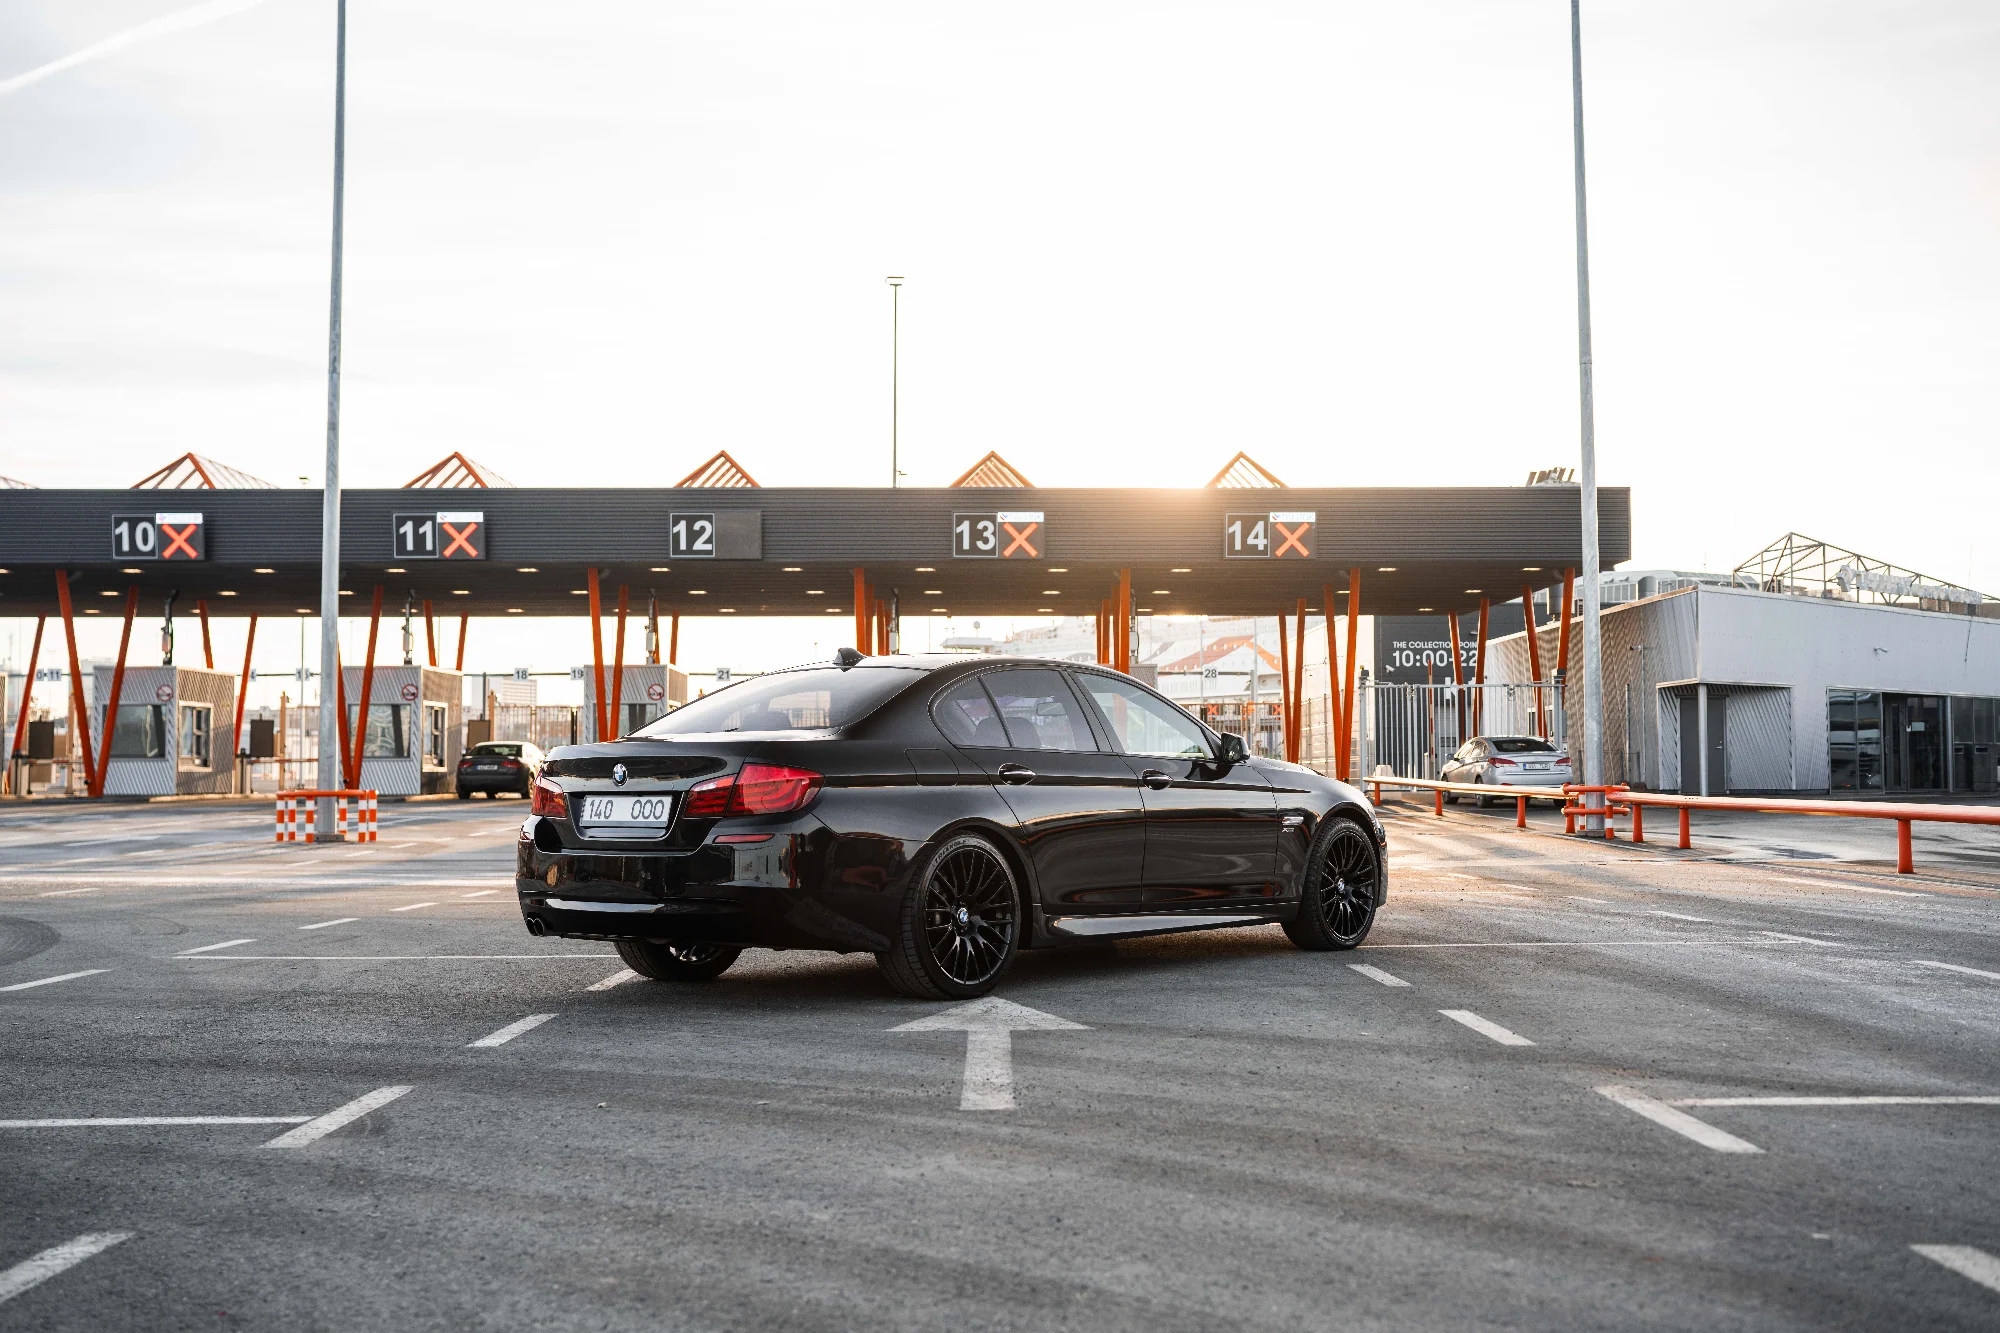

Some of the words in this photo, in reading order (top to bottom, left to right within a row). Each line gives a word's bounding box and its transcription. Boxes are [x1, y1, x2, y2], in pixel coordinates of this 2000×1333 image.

[115, 521, 155, 552] 10
[399, 520, 433, 551] 11
[672, 520, 713, 550] 12
[956, 520, 996, 550] 13
[1228, 520, 1268, 550] 14
[515, 670, 528, 679] 18
[572, 669, 584, 678] 19
[718, 670, 730, 680] 21
[1204, 668, 1217, 678] 28
[589, 799, 614, 820] 140
